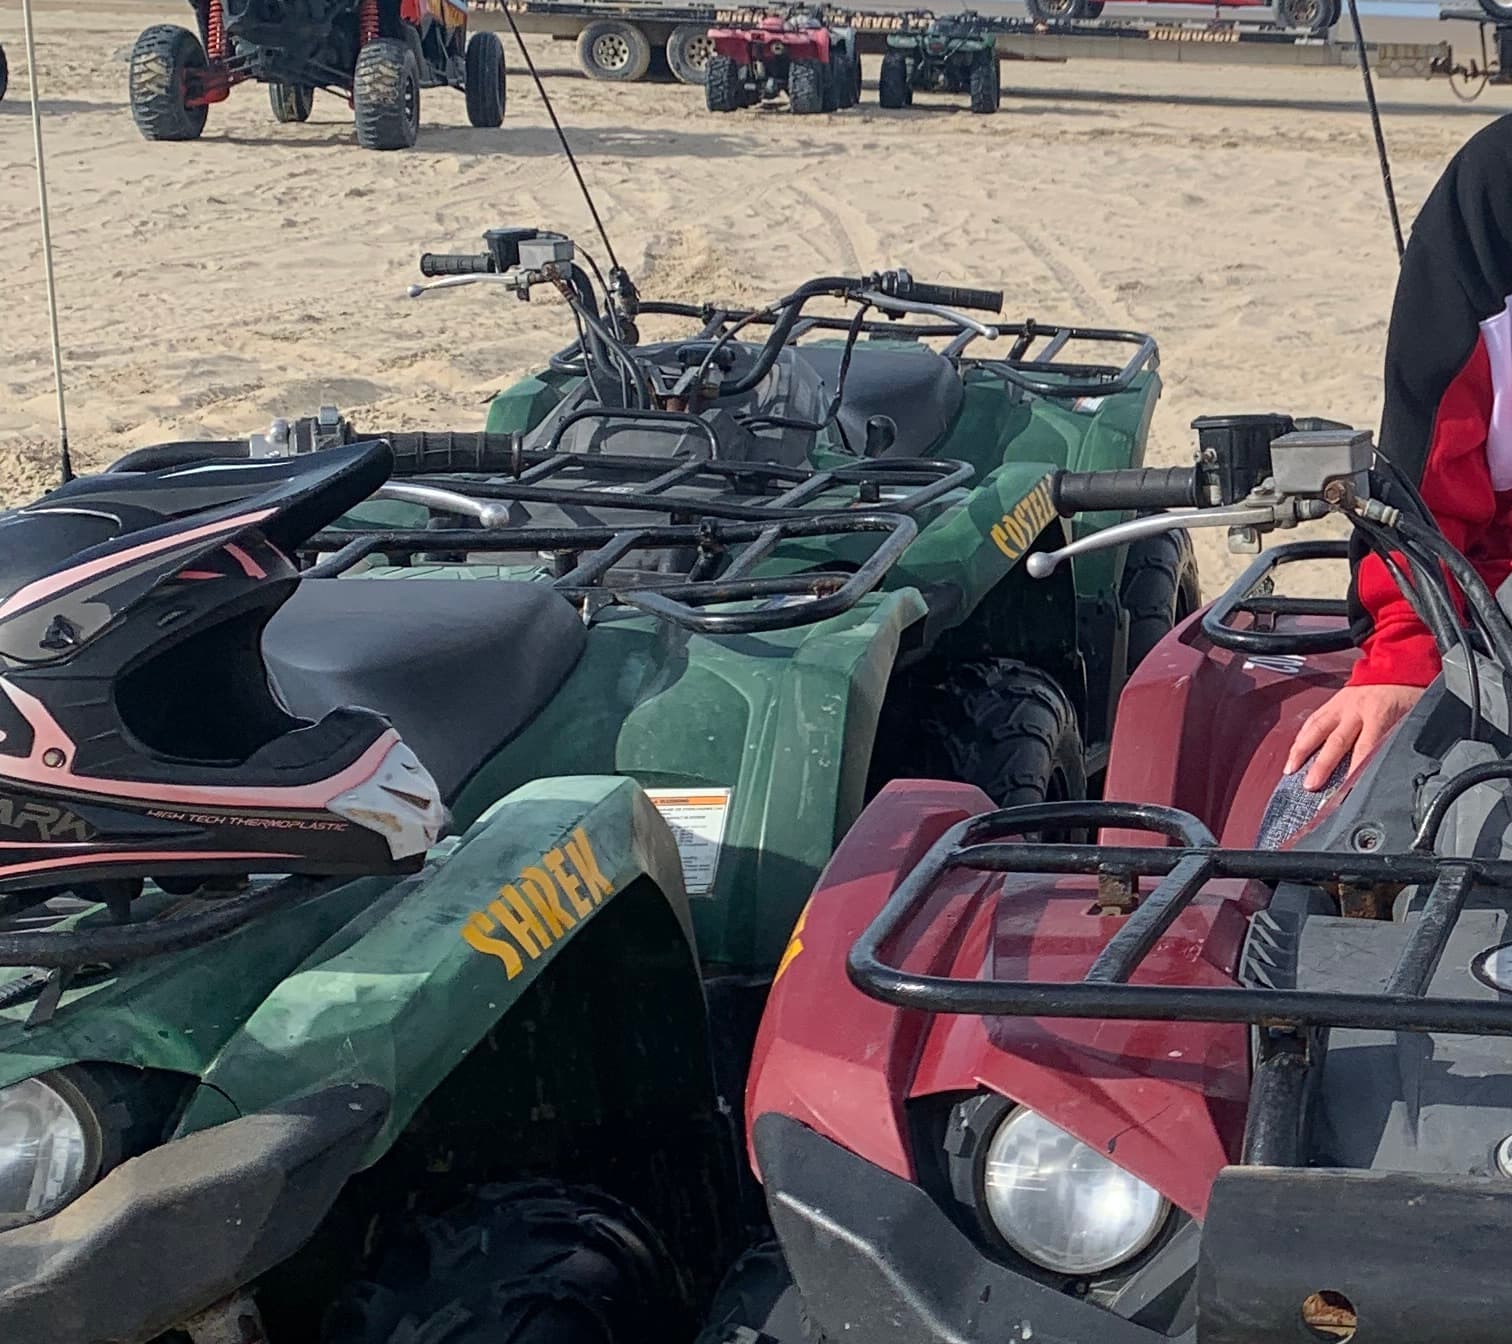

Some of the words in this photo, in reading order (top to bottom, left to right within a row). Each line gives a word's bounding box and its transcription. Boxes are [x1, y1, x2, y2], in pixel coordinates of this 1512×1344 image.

[990, 472, 1058, 560] COSTELL
[147, 808, 185, 820] HIGH
[188, 814, 225, 825] TECH
[229, 816, 349, 833] THERMOPLASTIC
[461, 827, 614, 981] SHREK
